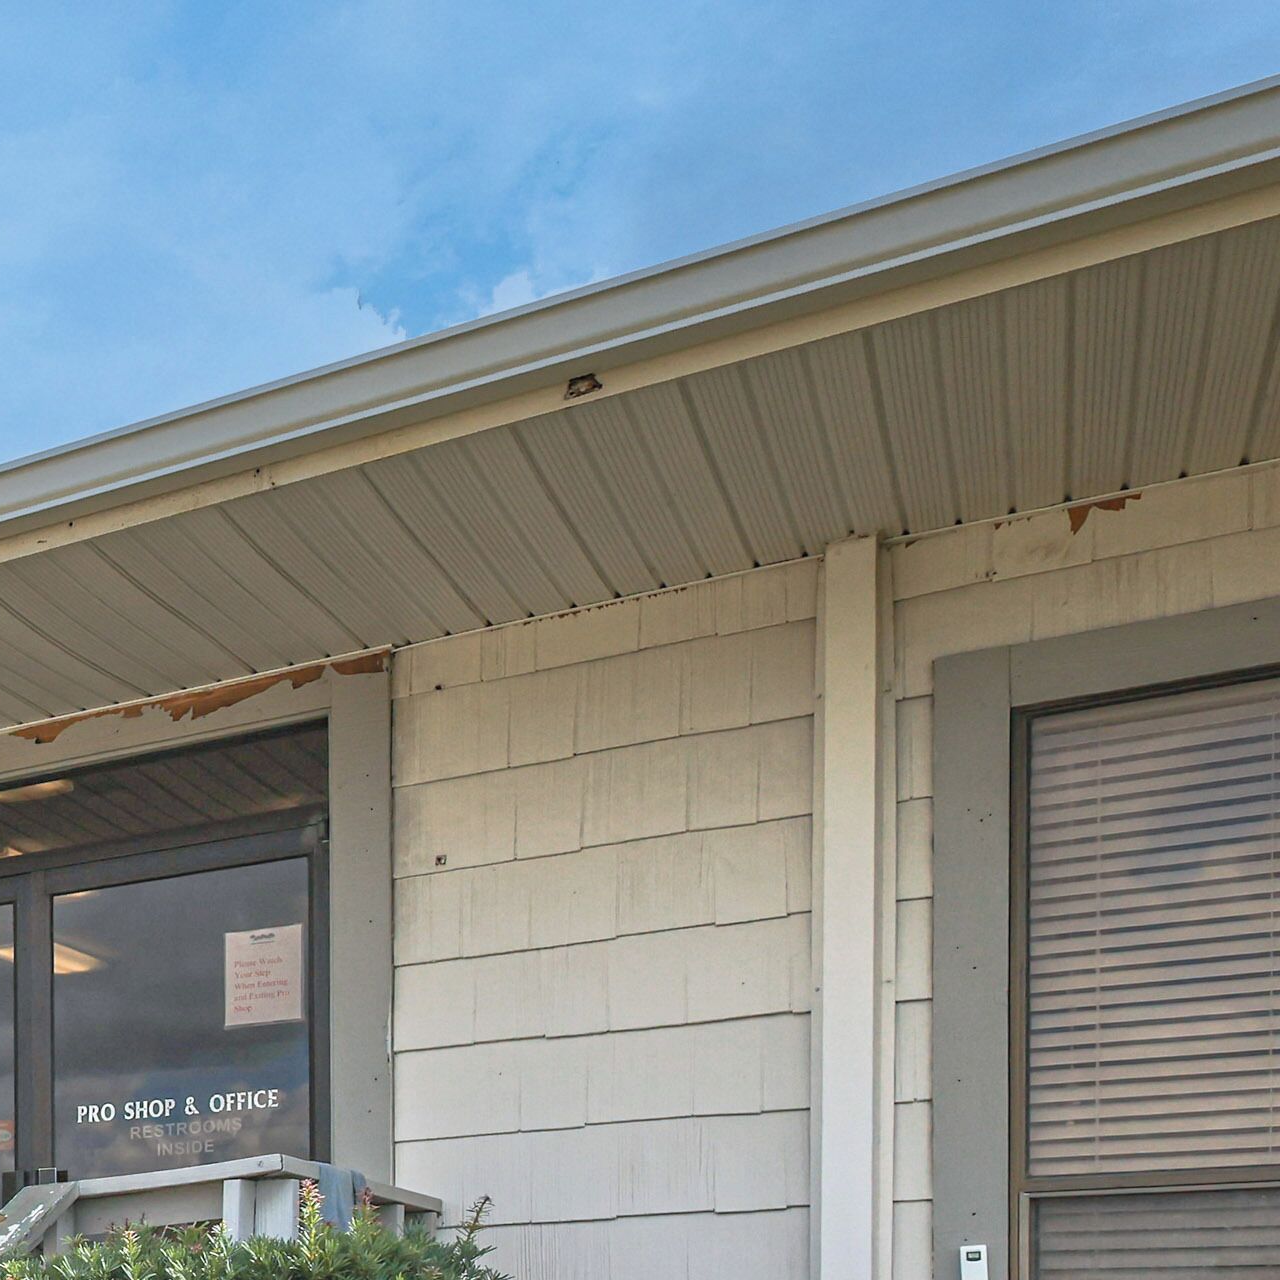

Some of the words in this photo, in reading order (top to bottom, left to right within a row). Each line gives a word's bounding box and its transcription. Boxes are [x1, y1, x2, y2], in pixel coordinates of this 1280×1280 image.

[76, 1103, 116, 1124] PRO
[124, 1098, 176, 1120] SHOP
[184, 1096, 200, 1115] &
[209, 1089, 279, 1114] OFFICE
[130, 1117, 243, 1140] RESTROOMS
[156, 1140, 215, 1156] INSIDE
